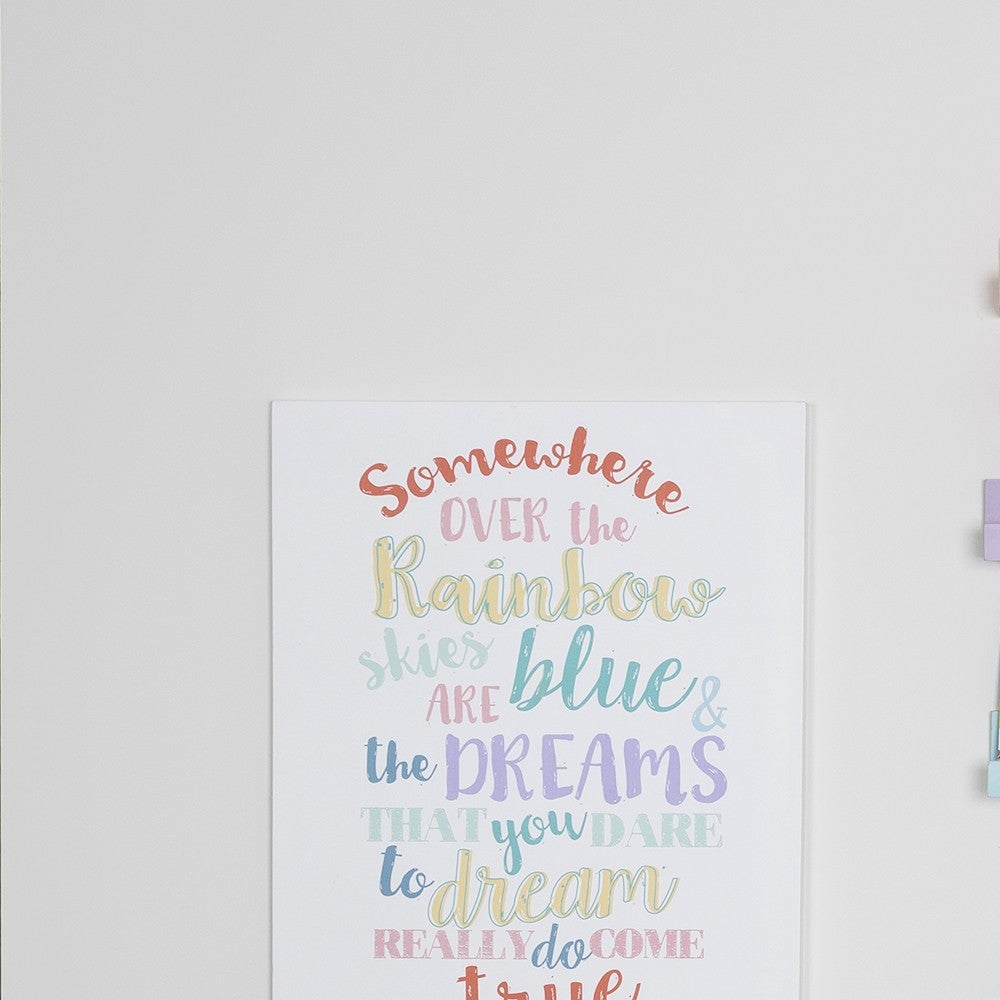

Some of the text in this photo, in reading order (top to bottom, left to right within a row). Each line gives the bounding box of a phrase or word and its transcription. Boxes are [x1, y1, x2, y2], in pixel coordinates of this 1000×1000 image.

[359, 425, 691, 519] Somewhere
[440, 497, 637, 545] OVER the
[371, 535, 726, 625] Rainbow
[359, 628, 494, 690] skies
[426, 624, 727, 732] ARE blue &
[364, 732, 728, 806] the DREAMS
[360, 807, 723, 876] THAT you DARE
[378, 844, 680, 928] to dream
[373, 923, 704, 970] REALLY do COME
